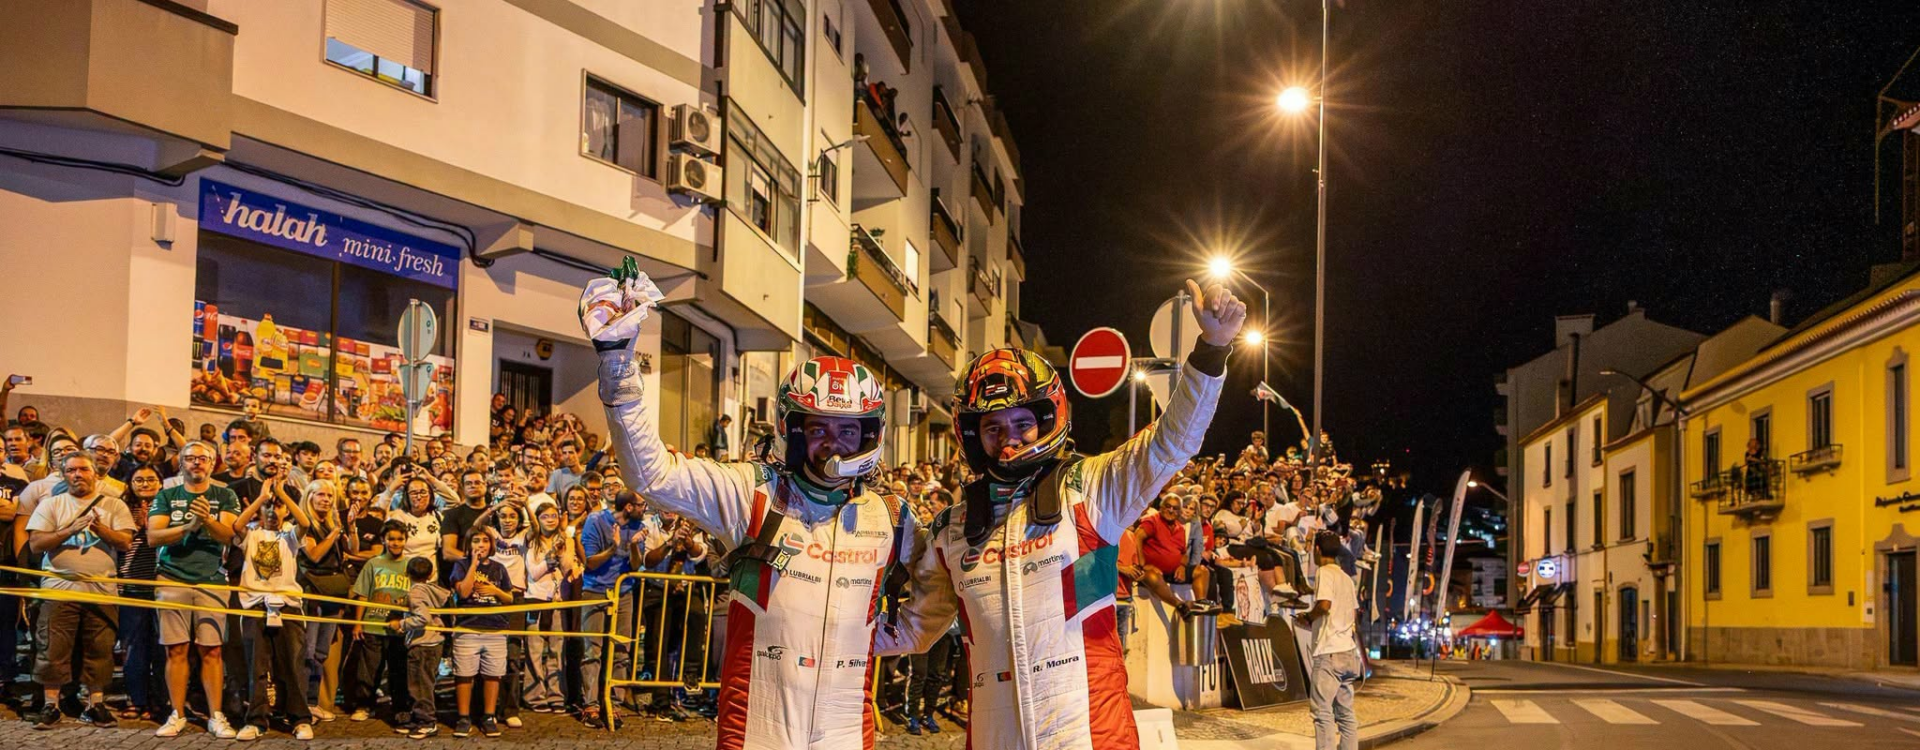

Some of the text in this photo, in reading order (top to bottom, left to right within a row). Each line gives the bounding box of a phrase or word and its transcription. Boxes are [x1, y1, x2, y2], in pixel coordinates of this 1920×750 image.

[223, 192, 328, 247] halah
[342, 237, 444, 277] mini fresh
[807, 542, 877, 564] Castrol
[982, 530, 1053, 565] Castrol
[1038, 553, 1065, 567] martins
[836, 660, 845, 668] P.
[1032, 655, 1080, 674] R. Moura
[1241, 638, 1276, 685] RALLY
